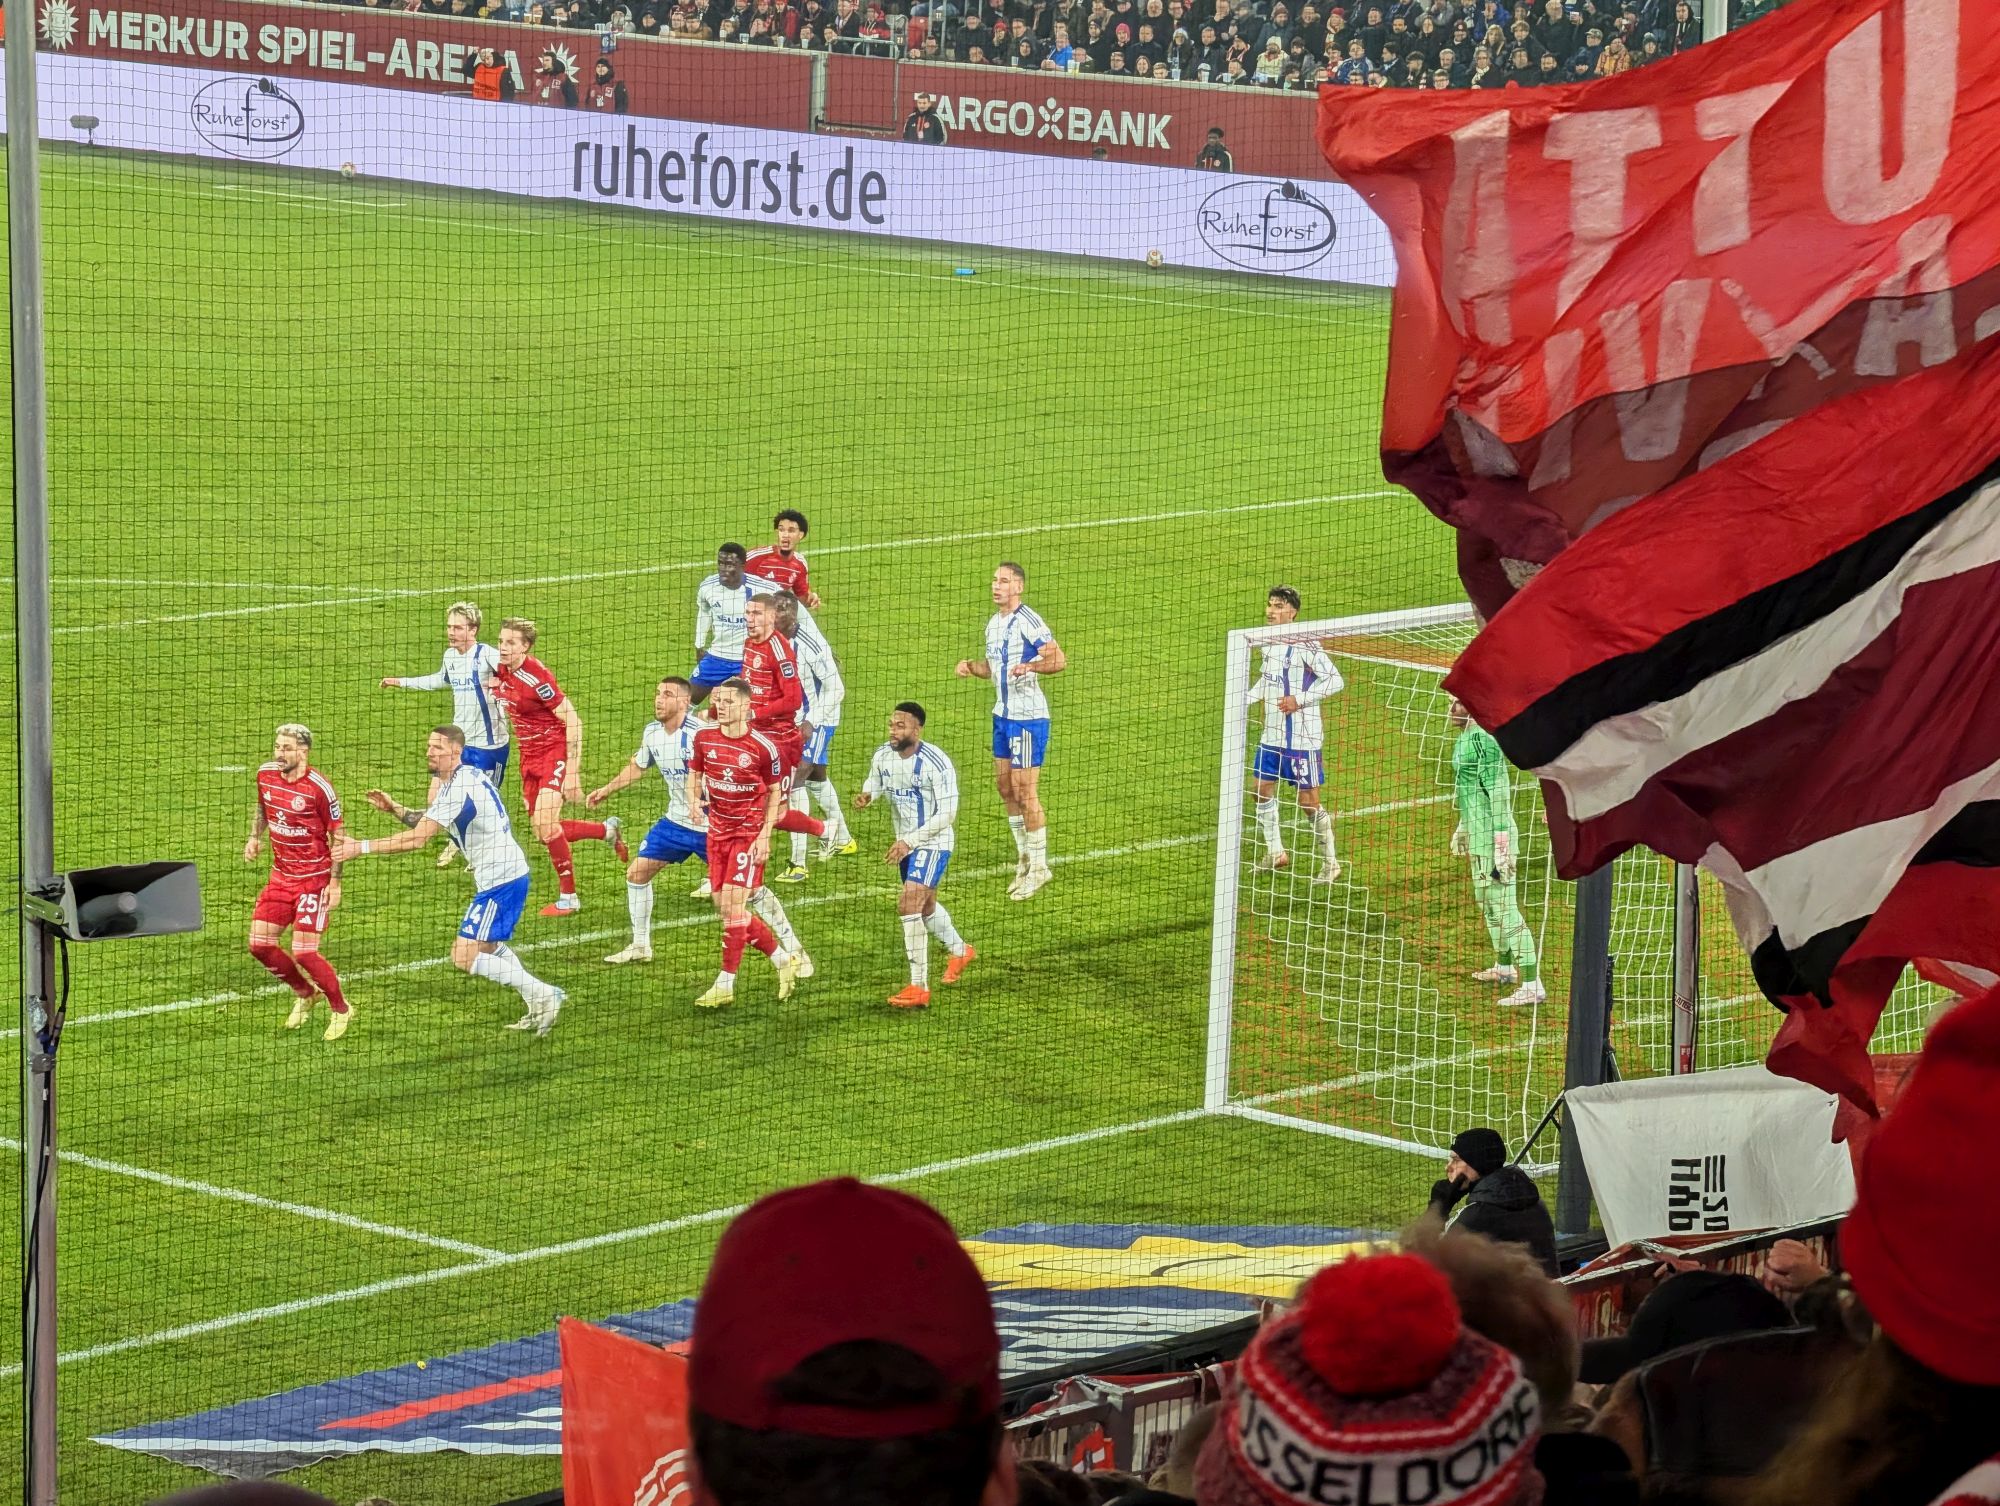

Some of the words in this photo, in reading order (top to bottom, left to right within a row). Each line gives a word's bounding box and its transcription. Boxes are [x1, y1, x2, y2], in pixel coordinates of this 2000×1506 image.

[88, 8, 249, 60] MERKUR
[194, 83, 289, 146] Ruheforst
[1067, 105, 1172, 149] BANK
[573, 124, 887, 225] ruheforst.de
[1201, 188, 1314, 257] Ruheforst
[553, 760, 565, 777] 2
[736, 852, 748, 870] 9
[297, 894, 318, 913] 25
[463, 902, 482, 924] 14
